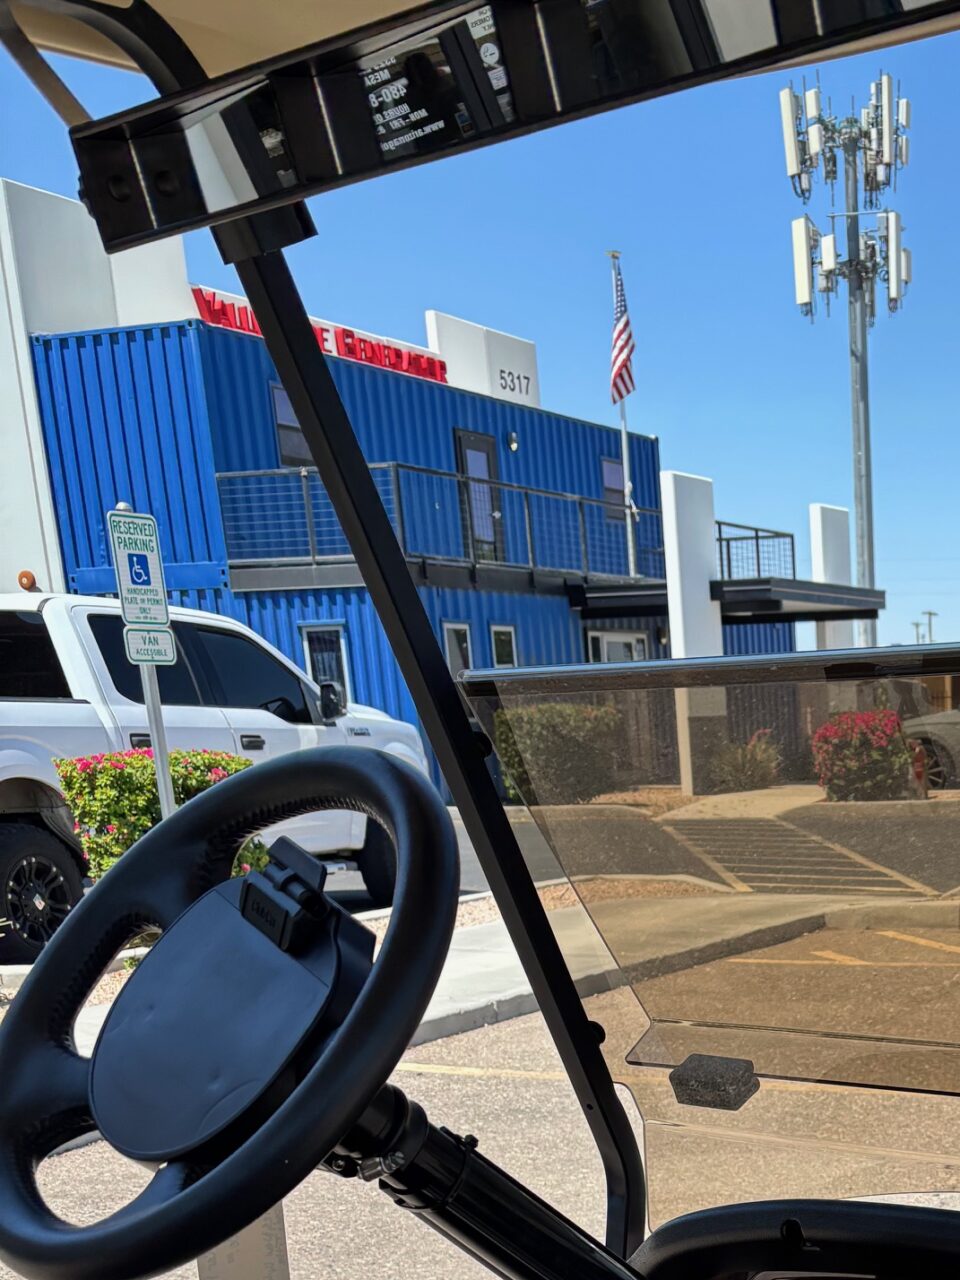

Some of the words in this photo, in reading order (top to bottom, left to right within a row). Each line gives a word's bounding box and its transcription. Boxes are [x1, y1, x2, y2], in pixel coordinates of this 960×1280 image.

[335, 326, 448, 384] GENERATOR
[500, 370, 531, 395] 5317
[112, 520, 154, 536] RESERVED
[117, 537, 155, 552] PARKING
[124, 596, 139, 605] PLATE
[141, 636, 159, 645] VAN
